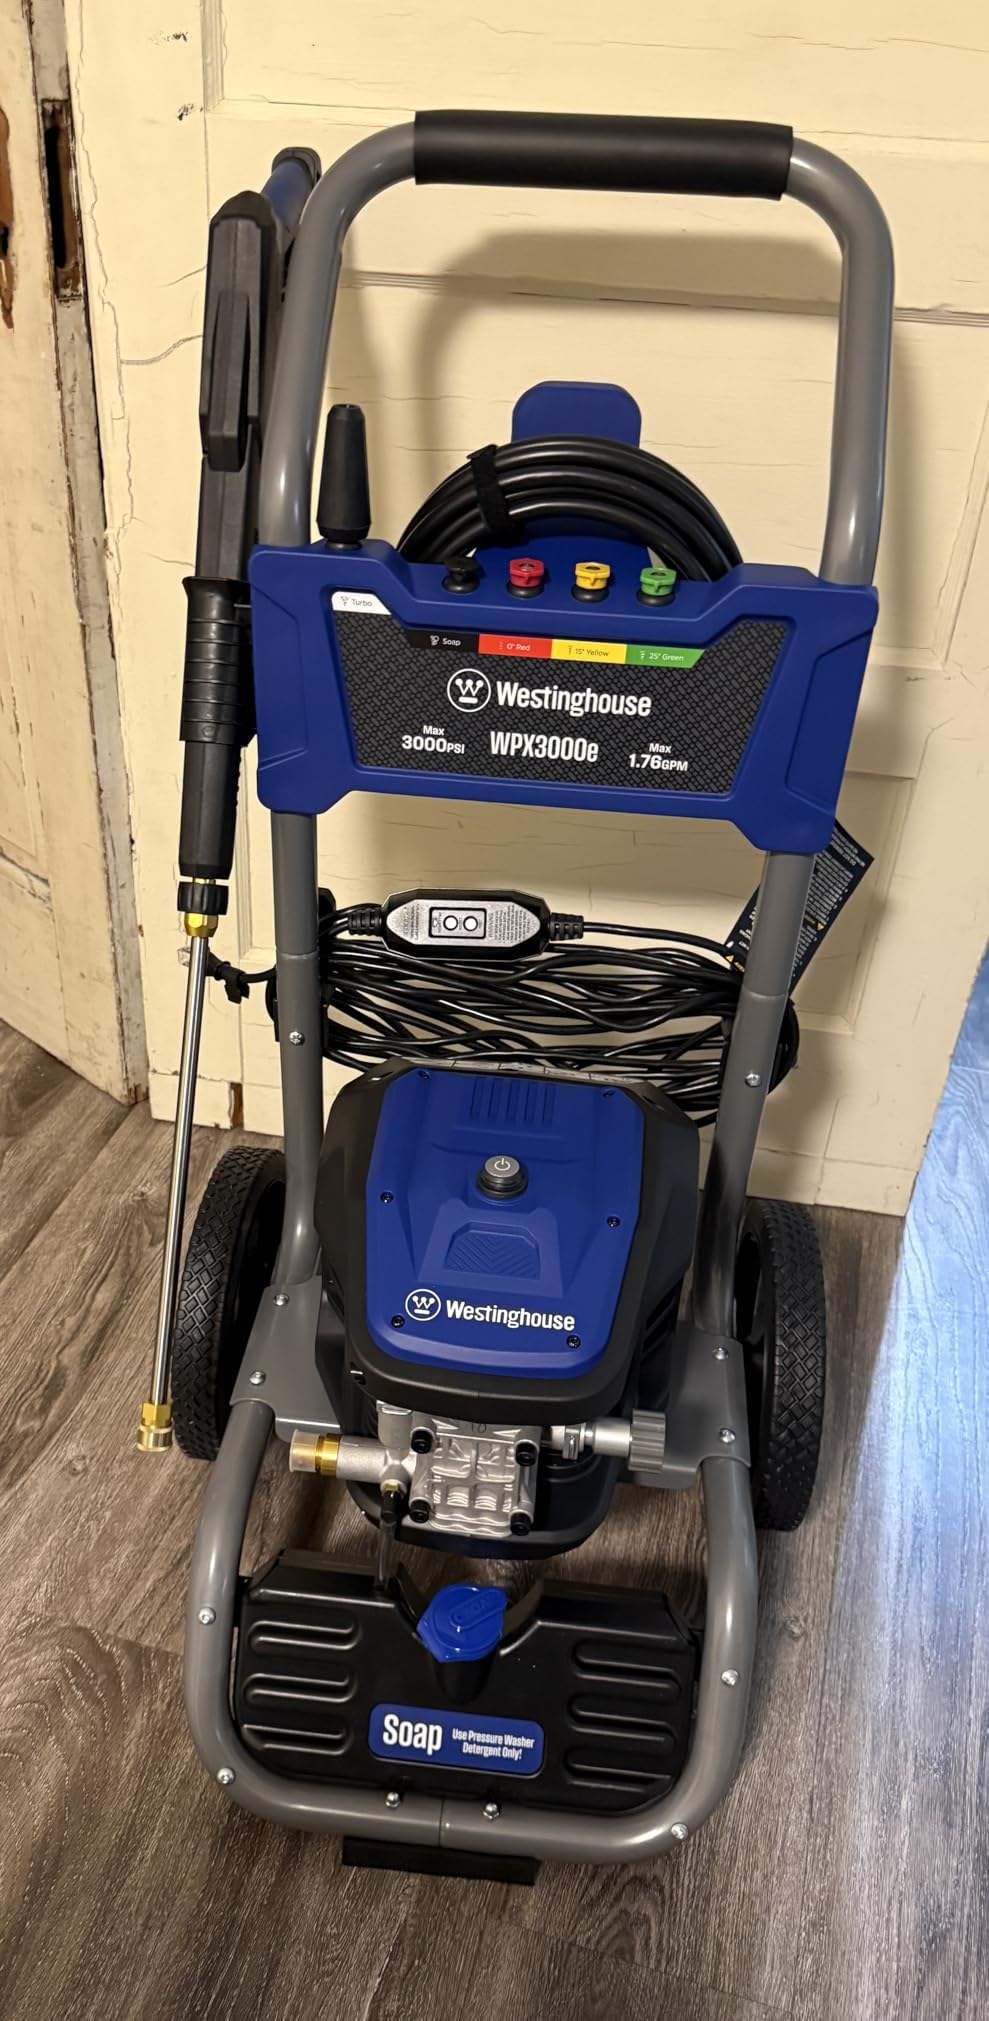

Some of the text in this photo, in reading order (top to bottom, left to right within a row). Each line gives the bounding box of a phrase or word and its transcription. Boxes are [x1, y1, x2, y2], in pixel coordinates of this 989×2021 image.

[352, 598, 373, 607] Turbo
[442, 637, 461, 647] Soap
[516, 643, 531, 651] Red
[586, 649, 609, 657] Yellow
[496, 681, 652, 717] Westinghouse
[423, 725, 445, 736] Max
[490, 731, 599, 763] WPX3000e
[649, 743, 672, 754] Max
[446, 1299, 575, 1331] Westinghouse
[382, 1713, 443, 1756] Soap
[452, 1728, 535, 1749] Use Pressure Washer
[462, 1742, 523, 1761] Detergent Only!
